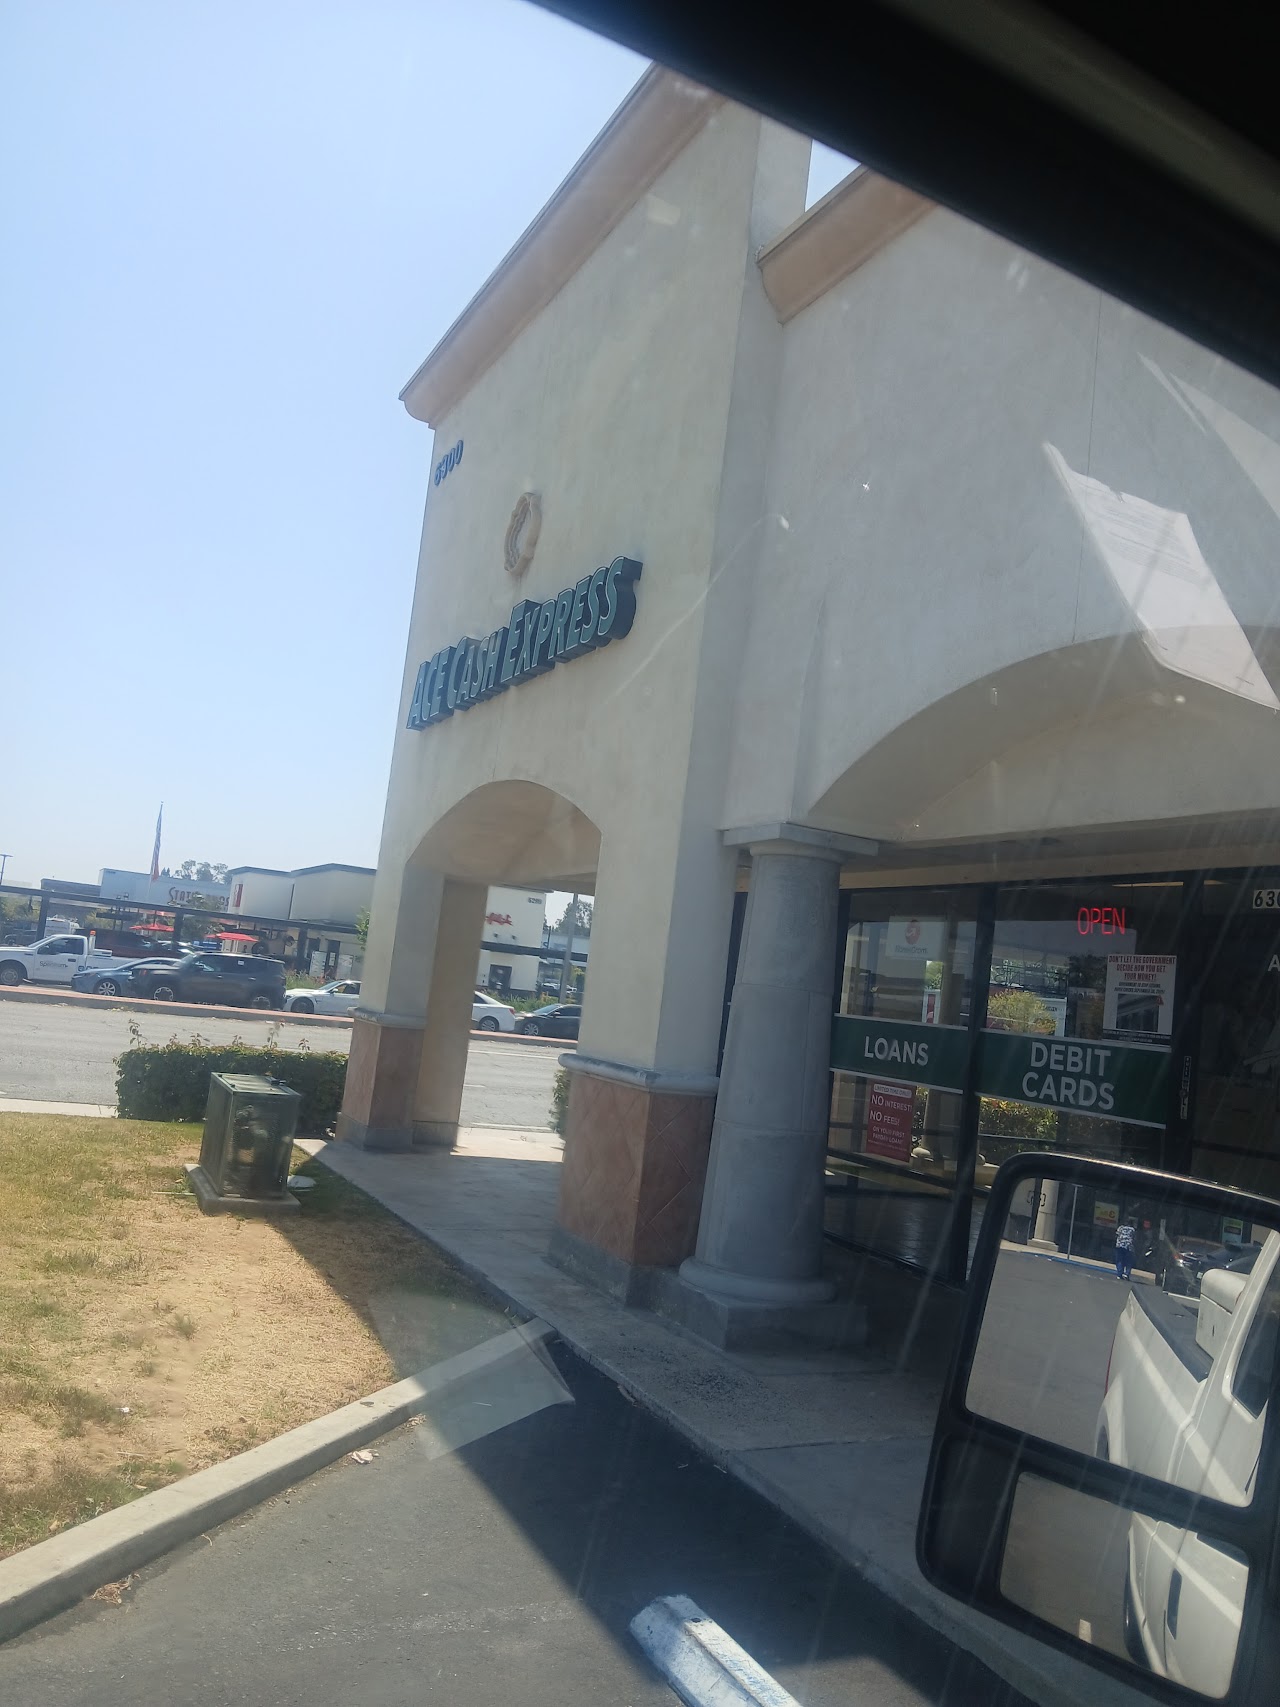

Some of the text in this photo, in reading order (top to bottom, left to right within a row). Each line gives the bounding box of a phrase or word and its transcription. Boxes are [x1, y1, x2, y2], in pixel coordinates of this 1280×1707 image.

[434, 439, 464, 486] 6300
[406, 646, 454, 730] ACE
[1254, 890, 1280, 908] 63
[1077, 907, 1126, 935] OPEN
[1133, 956, 1141, 964] THE
[1143, 956, 1176, 964] GOVERNMENT
[1134, 964, 1145, 972] HOW
[864, 1035, 929, 1066] LOANS
[1030, 1041, 1111, 1076] DEBIT
[1022, 1071, 1115, 1110] CARDS
[871, 1094, 912, 1112] NO INTEREST!
[870, 1110, 900, 1126] NO FEES!
[893, 1130, 905, 1138] FIRST
